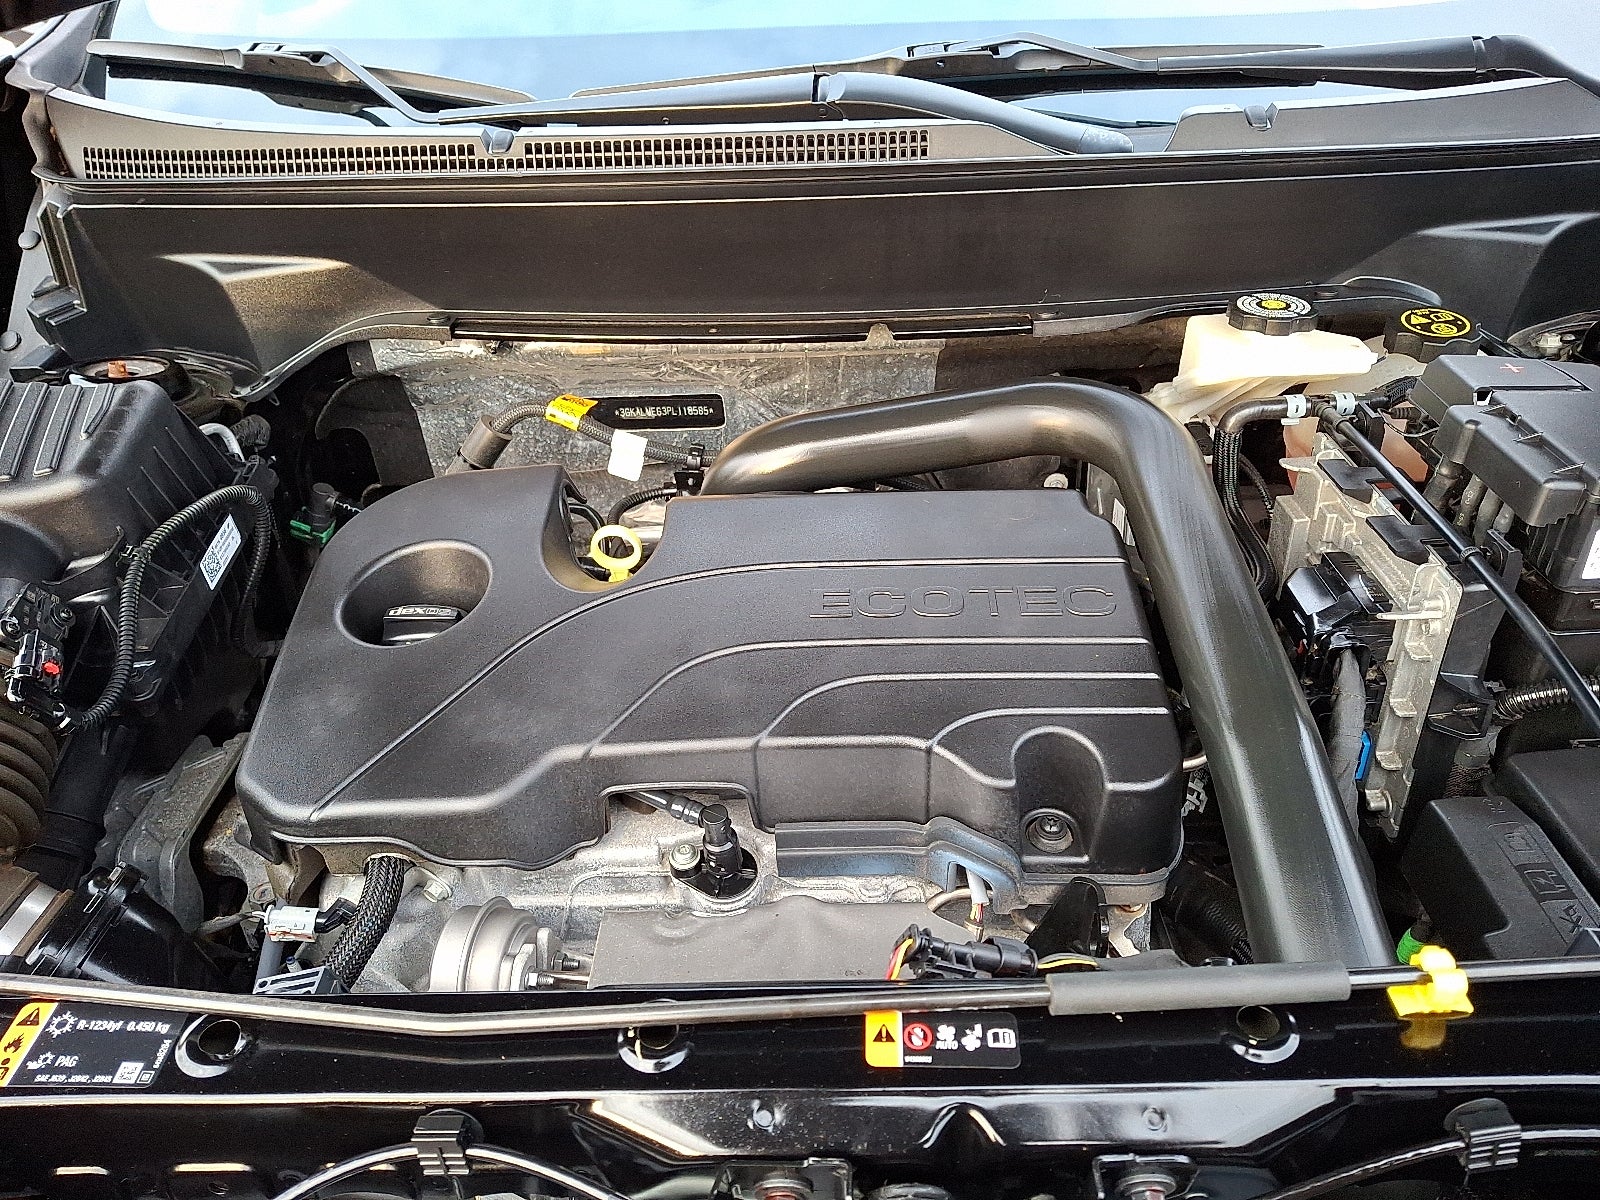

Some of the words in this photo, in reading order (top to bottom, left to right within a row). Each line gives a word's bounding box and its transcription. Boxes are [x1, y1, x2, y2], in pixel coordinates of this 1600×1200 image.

[809, 584, 1117, 618] ECOTEC
[76, 1020, 124, 1033] R-1234yf
[126, 1021, 155, 1032] 0.450
[154, 1021, 171, 1034] kg
[935, 1040, 958, 1049] AUTO
[54, 1056, 79, 1068] PAG
